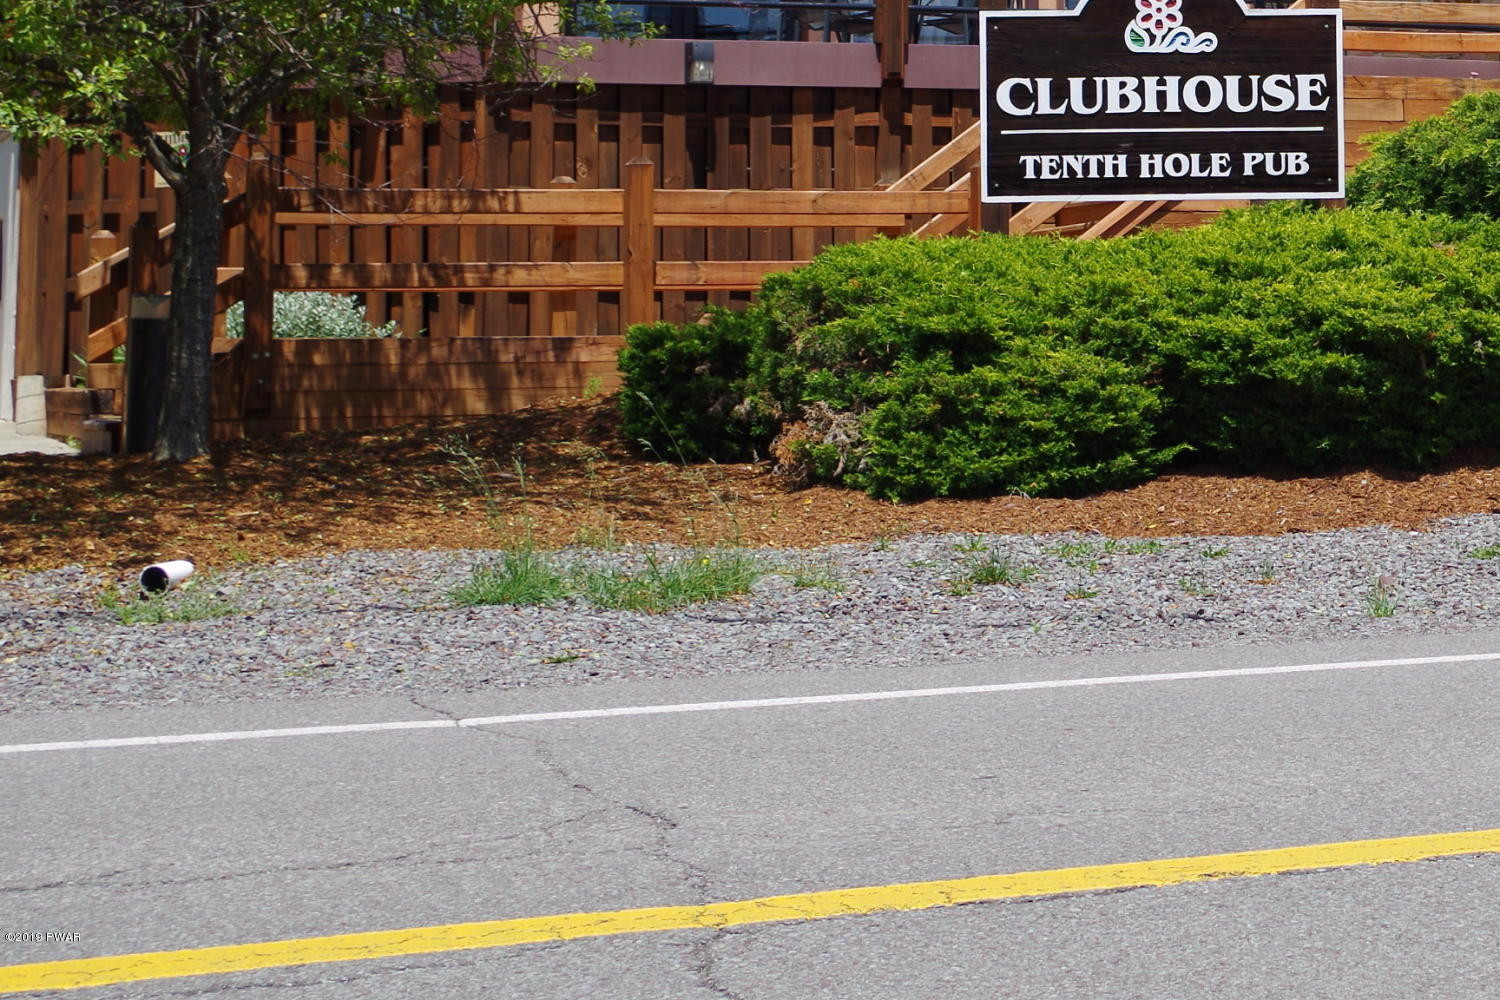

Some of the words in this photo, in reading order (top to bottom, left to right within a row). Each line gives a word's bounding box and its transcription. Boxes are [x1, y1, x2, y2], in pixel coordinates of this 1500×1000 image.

[995, 73, 1331, 116] CLUBHOUSE
[1018, 154, 1128, 180] TENTH
[1139, 152, 1232, 178] HOLE
[1242, 151, 1311, 176] PUB
